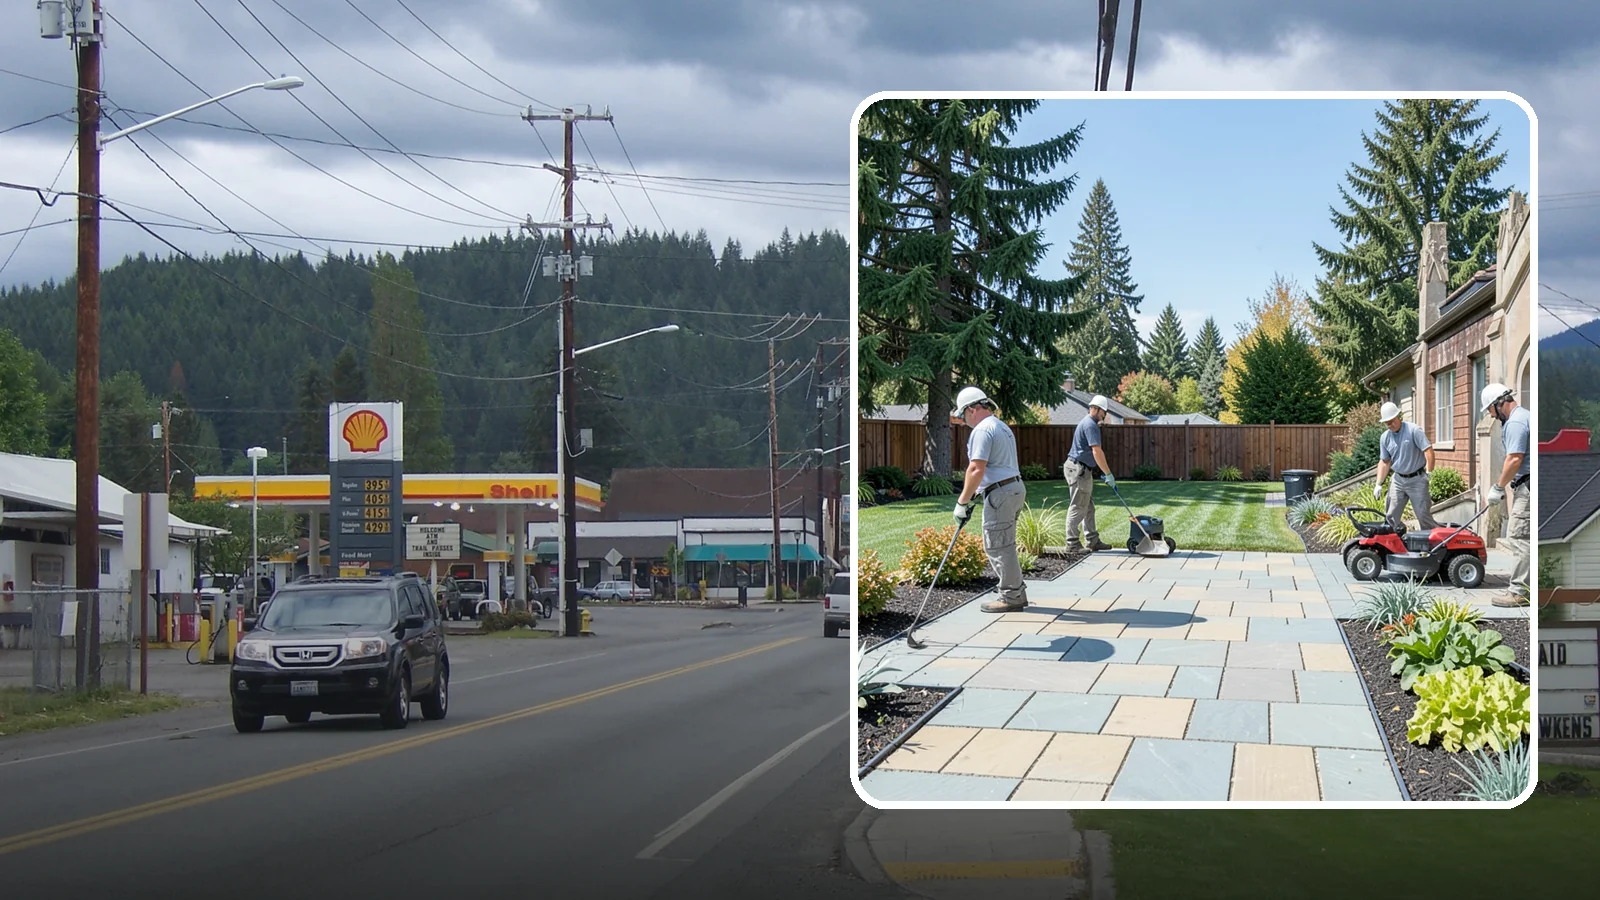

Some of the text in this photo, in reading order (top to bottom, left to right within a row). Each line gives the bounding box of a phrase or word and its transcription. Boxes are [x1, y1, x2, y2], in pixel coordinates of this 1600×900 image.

[365, 480, 383, 490] 395
[490, 484, 547, 499] Shell
[365, 494, 383, 504] 405
[365, 508, 383, 518] 415
[365, 522, 383, 532] 429
